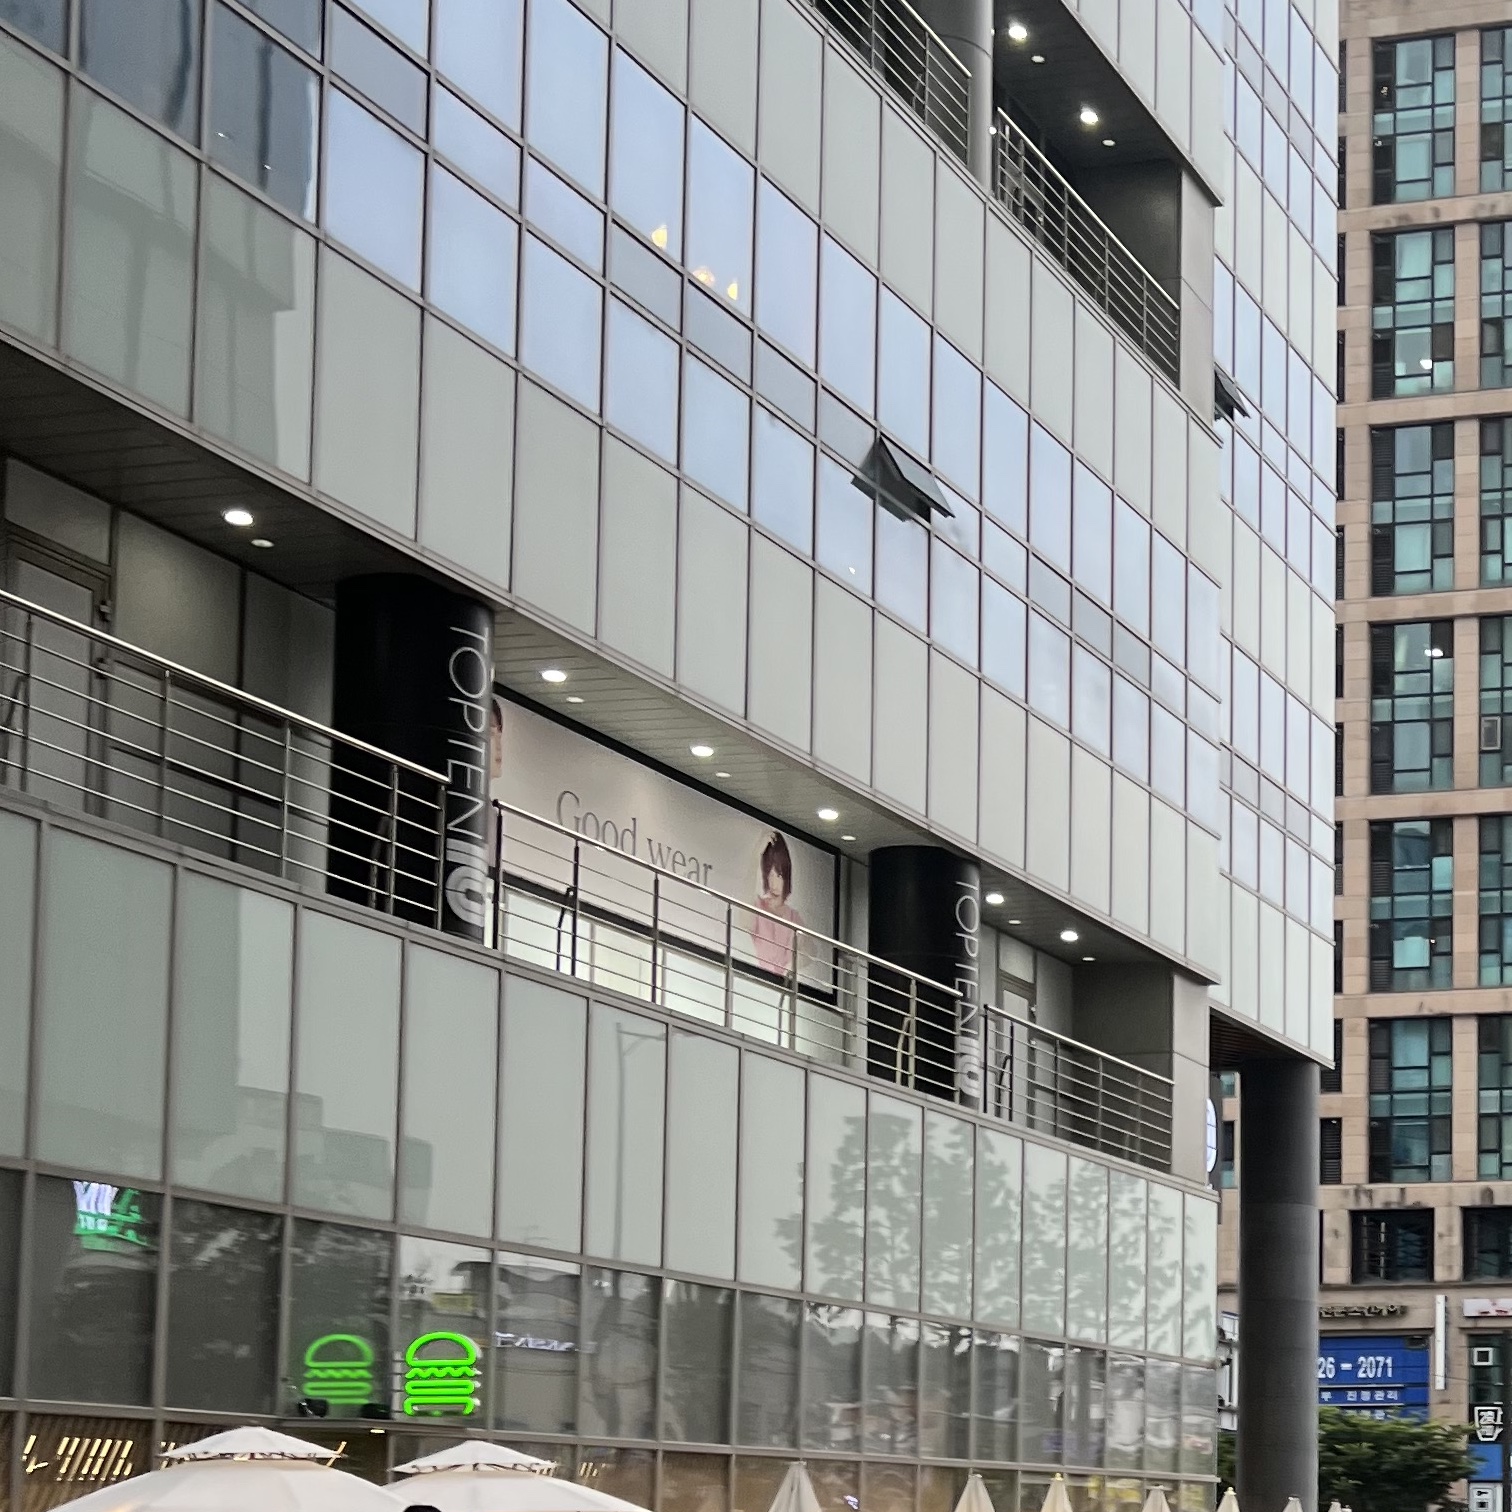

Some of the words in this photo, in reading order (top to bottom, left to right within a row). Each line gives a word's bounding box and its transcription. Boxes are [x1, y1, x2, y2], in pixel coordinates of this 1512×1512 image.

[556, 789, 637, 858] Good
[646, 836, 713, 887] wear
[1357, 1355, 1394, 1379] 2071
